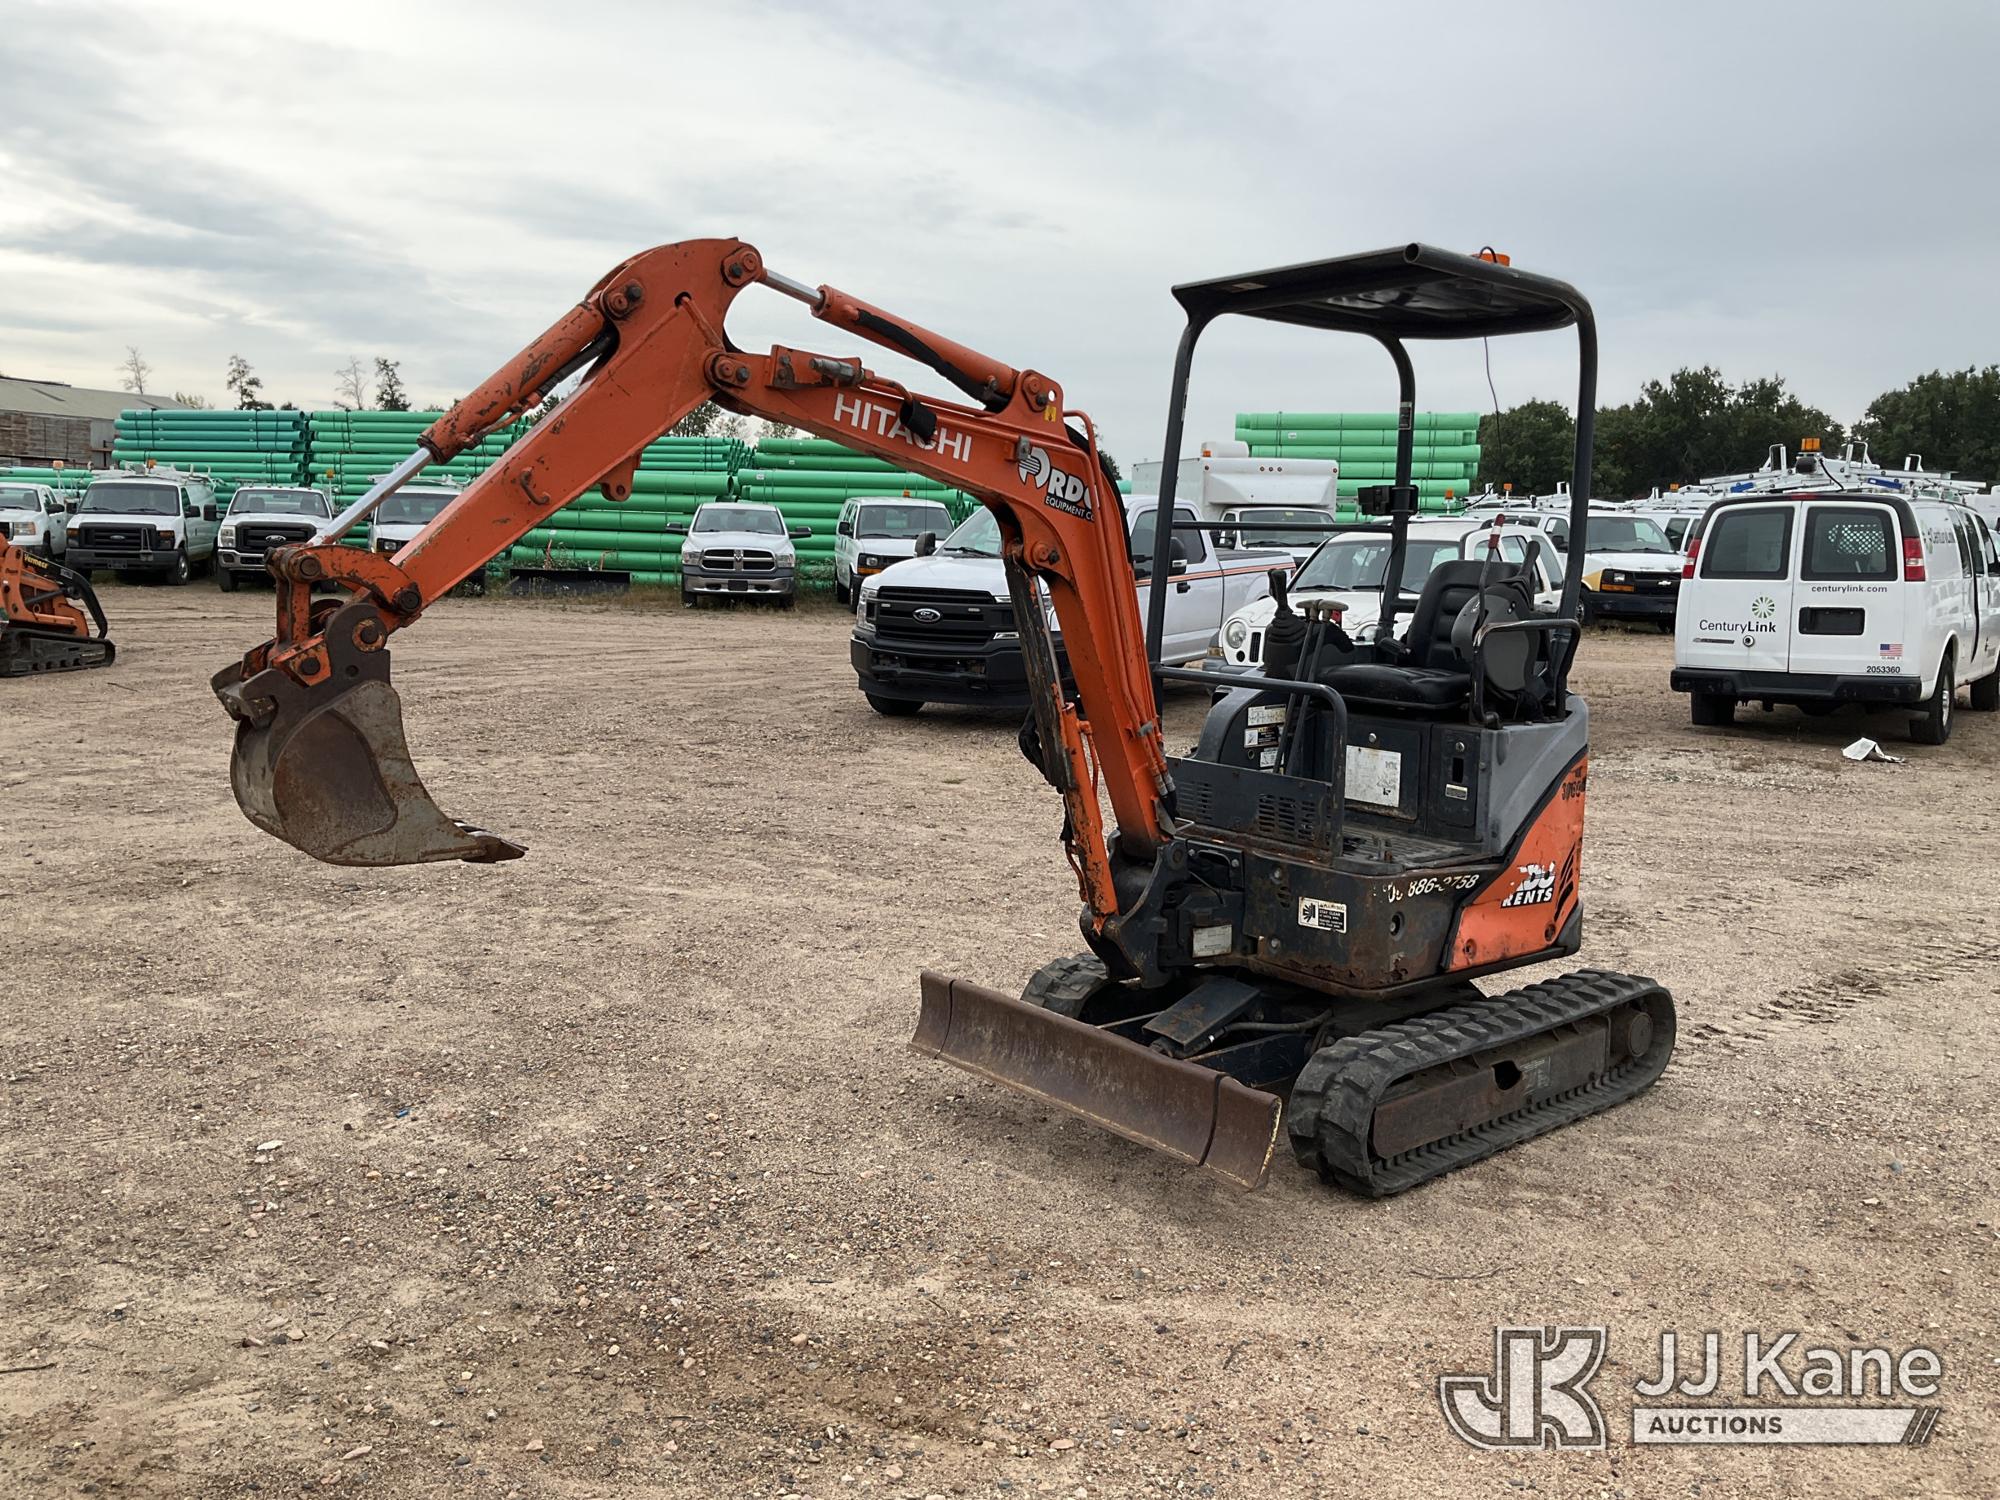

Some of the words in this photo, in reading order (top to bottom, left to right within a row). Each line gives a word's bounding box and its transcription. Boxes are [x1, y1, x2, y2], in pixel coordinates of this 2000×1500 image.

[834, 393, 972, 463] HITACHI
[1045, 496, 1085, 517] EQUIPMENT
[1811, 584, 1888, 594] centurylink.com
[1699, 619, 1777, 635] CenturyLink
[1866, 665, 1901, 674] 2053360
